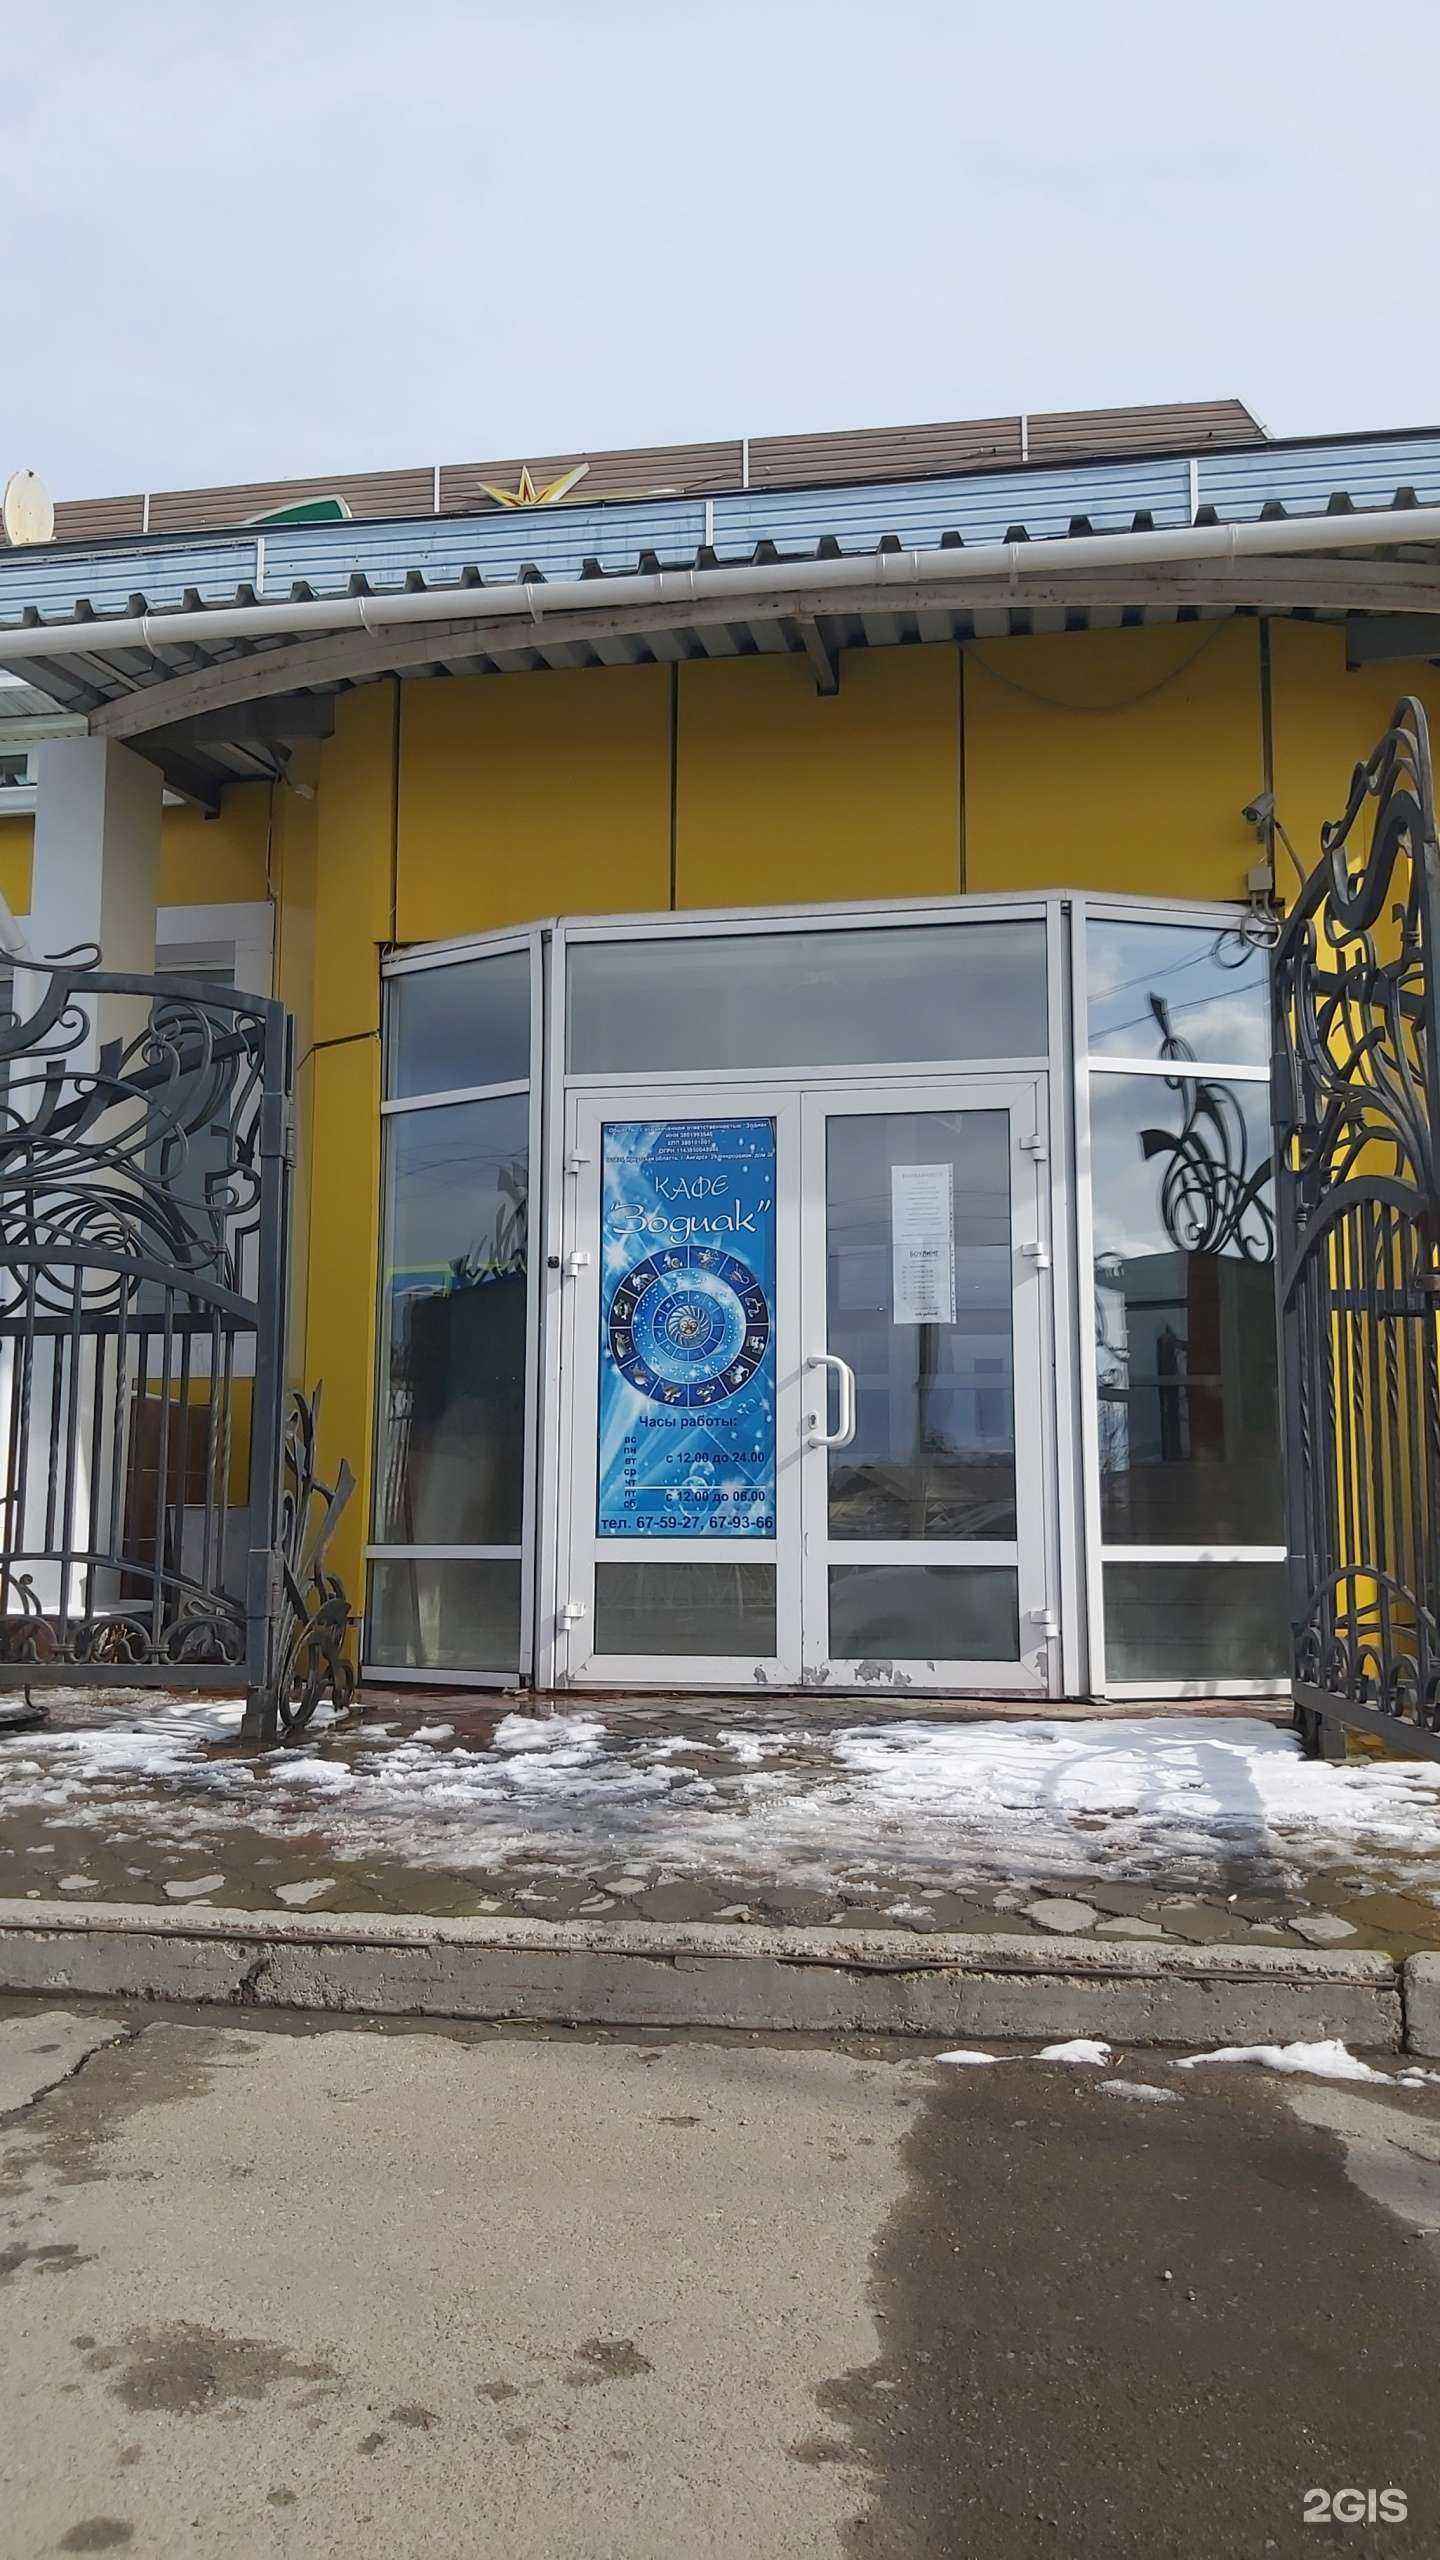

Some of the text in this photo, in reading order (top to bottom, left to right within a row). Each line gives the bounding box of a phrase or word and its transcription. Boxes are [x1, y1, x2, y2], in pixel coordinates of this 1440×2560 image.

[655, 1175, 729, 1201] КАФЕ
[639, 1416, 737, 1429] Часы работы:
[666, 1452, 765, 1464] с 12.00 до 24.00
[624, 1468, 637, 1477] ср
[666, 1494, 672, 1502] с
[677, 1492, 709, 1501] 12.00
[712, 1492, 729, 1502] до
[624, 1500, 637, 1508] сб
[601, 1516, 773, 1530] тел. 67-59-27, 67-93-66
